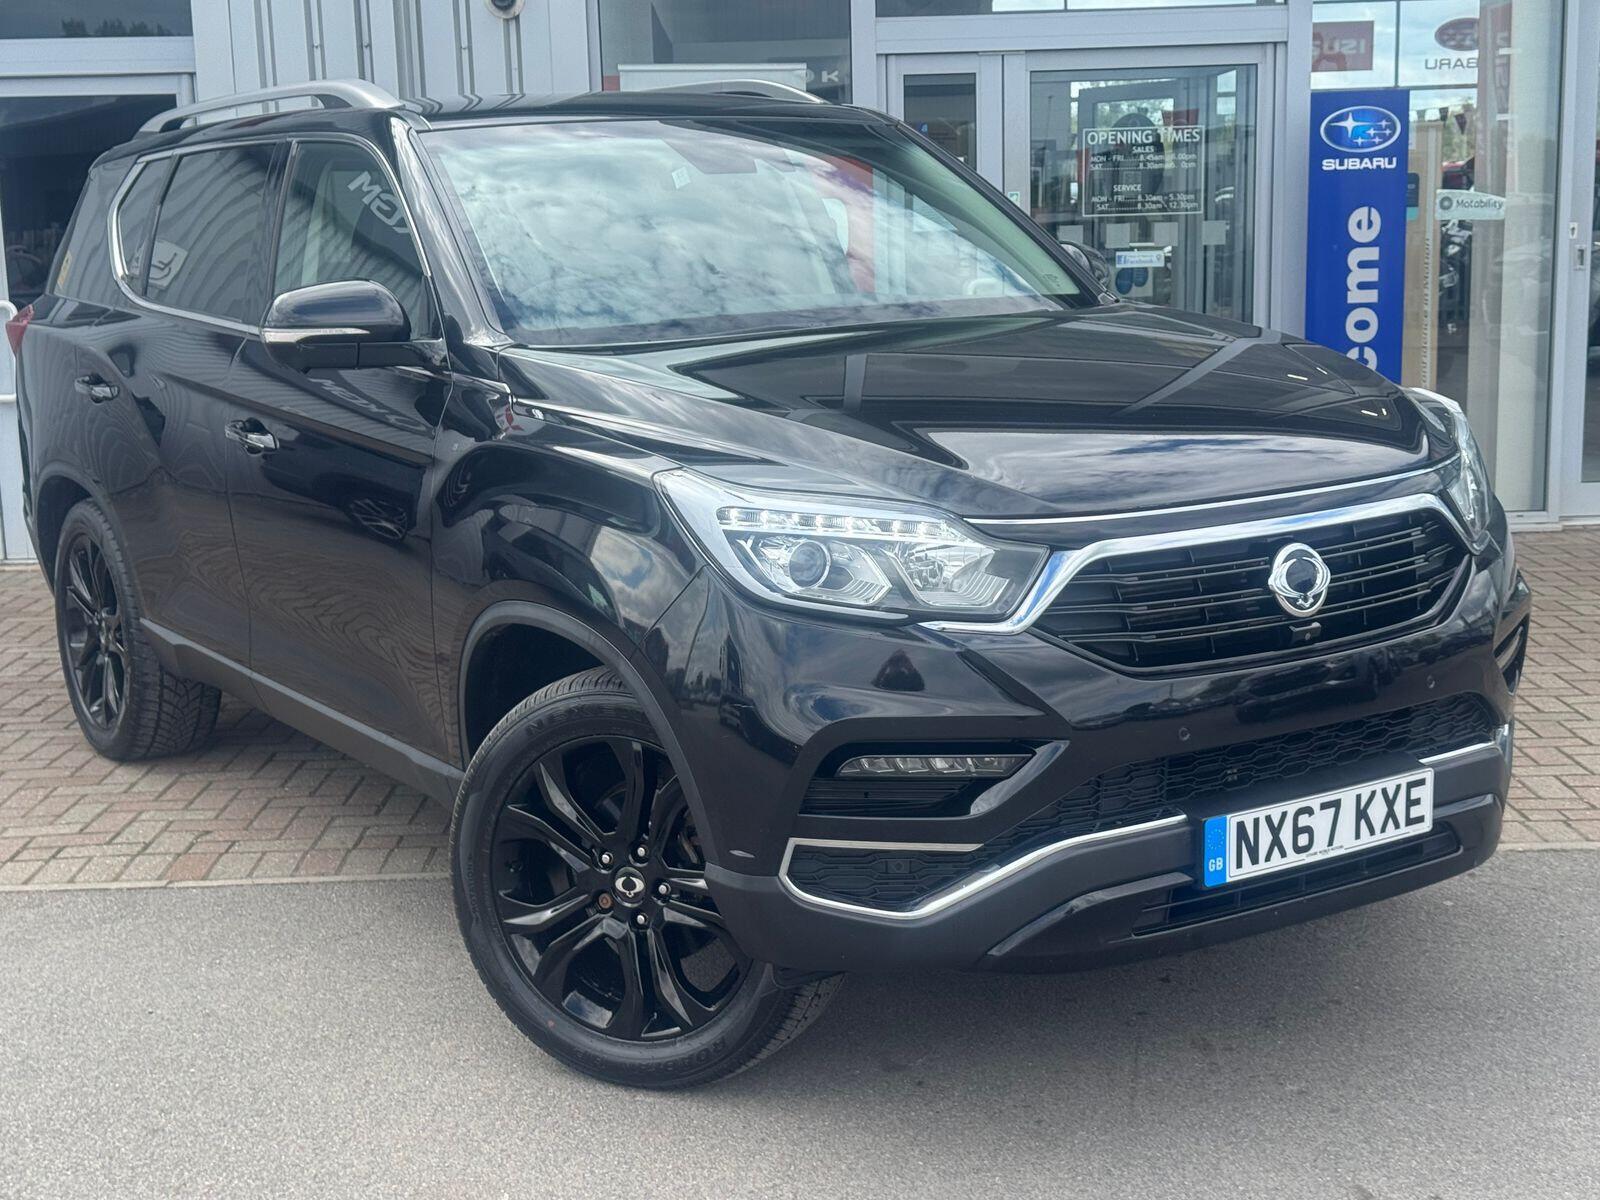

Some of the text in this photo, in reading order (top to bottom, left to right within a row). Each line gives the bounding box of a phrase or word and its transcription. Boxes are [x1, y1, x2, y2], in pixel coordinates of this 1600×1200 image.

[1087, 128, 1201, 145] OPENING TIMES
[1322, 157, 1397, 171] SUBARU
[1113, 184, 1142, 192] SERVICE
[1456, 198, 1503, 211] Motability
[1236, 777, 1426, 870] NX67 KXE
[1208, 857, 1223, 872] GB
